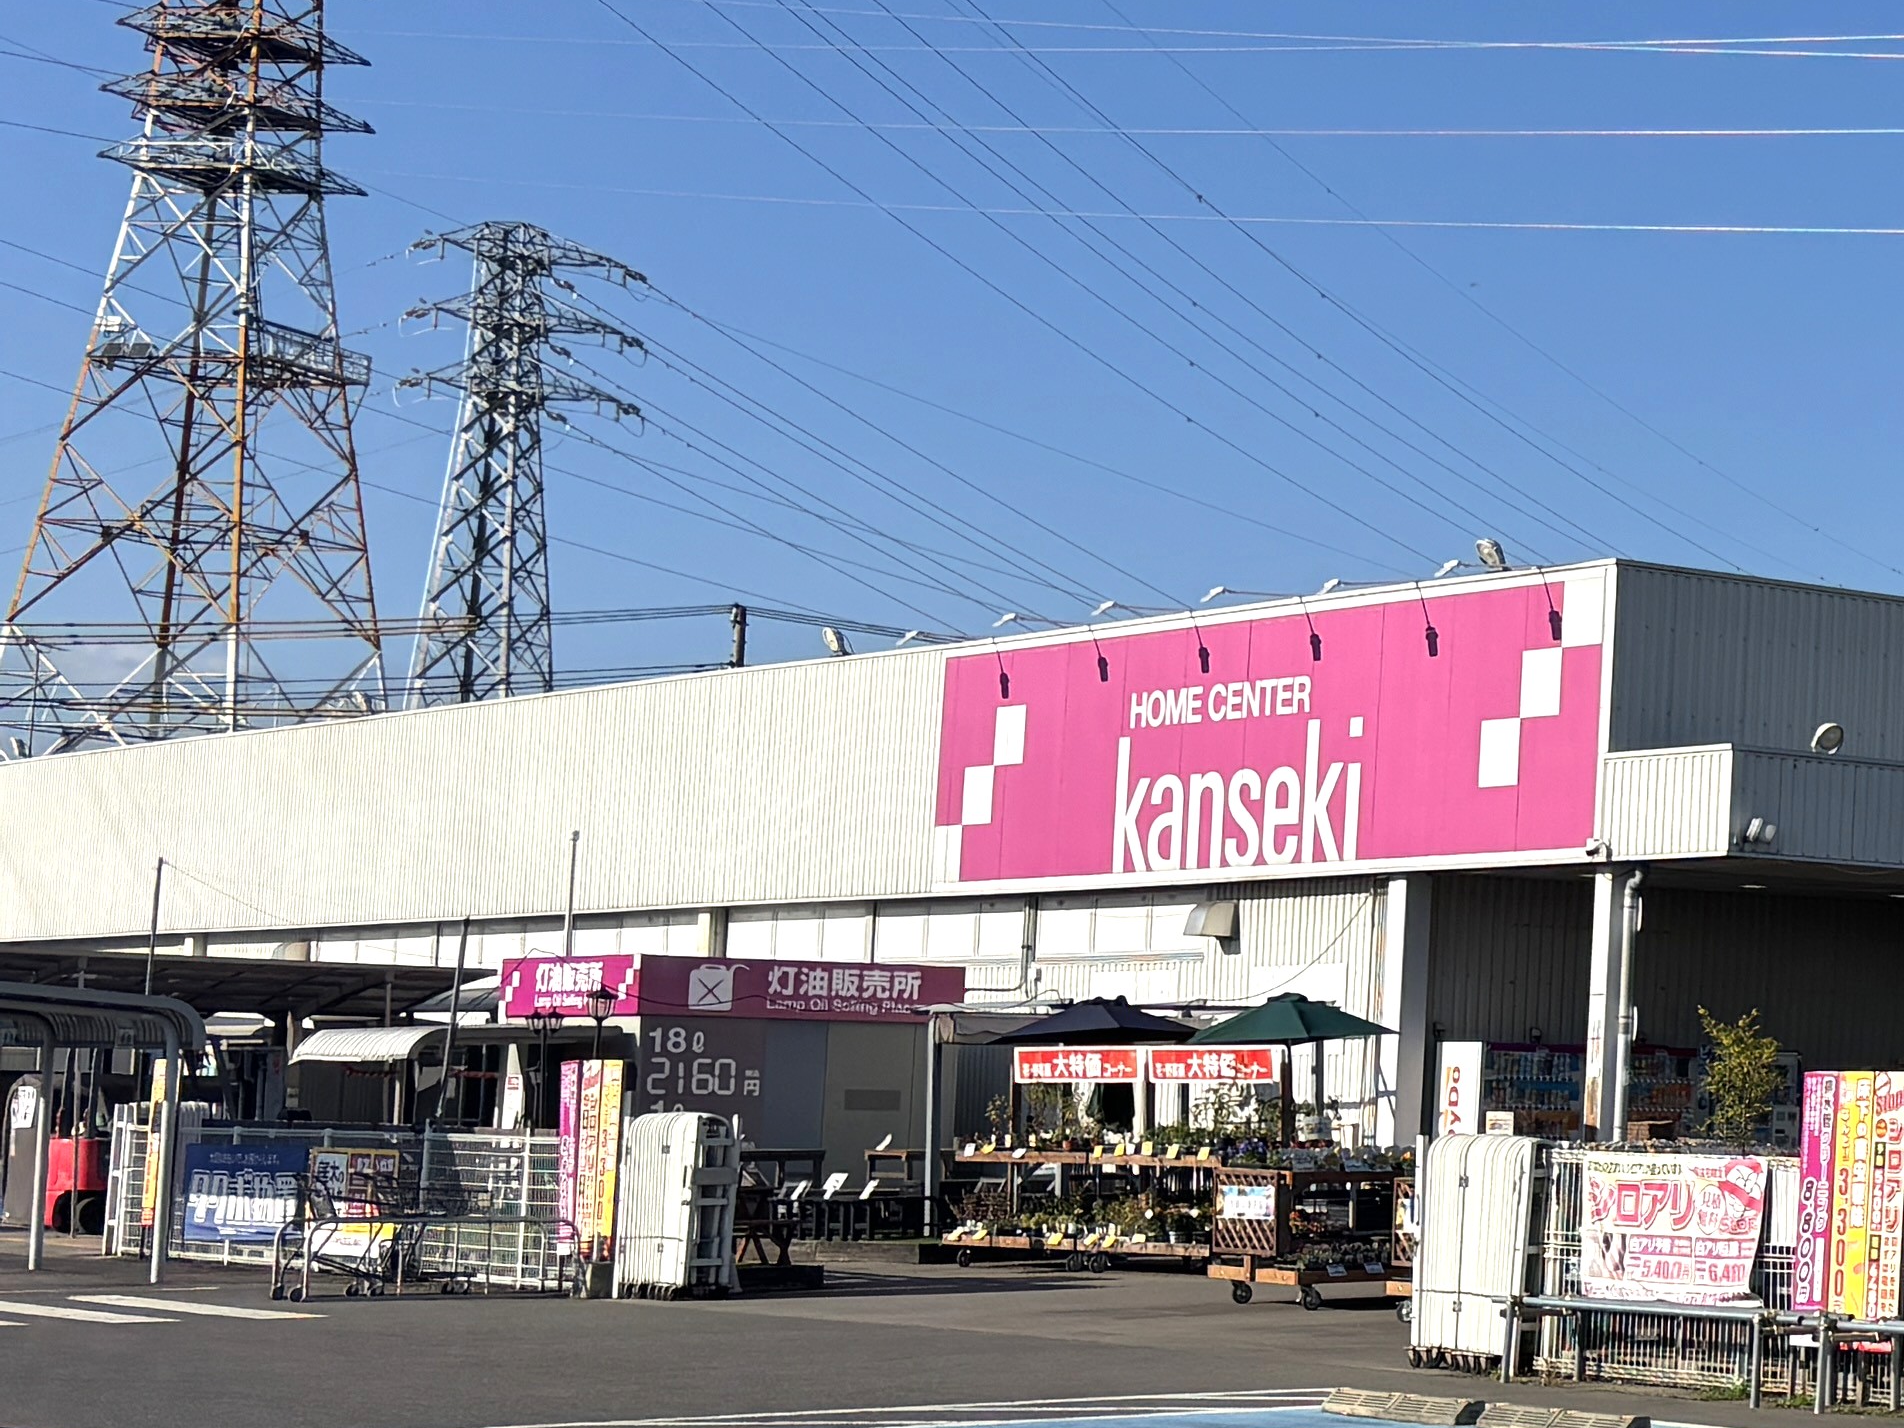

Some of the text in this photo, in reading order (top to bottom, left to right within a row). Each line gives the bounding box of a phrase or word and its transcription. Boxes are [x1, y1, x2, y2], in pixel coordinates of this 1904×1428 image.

[1130, 675, 1311, 729] HOME CENTER
[1112, 717, 1363, 873] kanseki
[767, 965, 922, 1001] 灯油販売所
[810, 998, 829, 1012] Oil
[646, 1057, 737, 1096] 2160
[743, 1079, 760, 1097] 円
[1884, 1118, 1904, 1233] シロアリ
[1587, 1176, 1696, 1231] シロアリ
